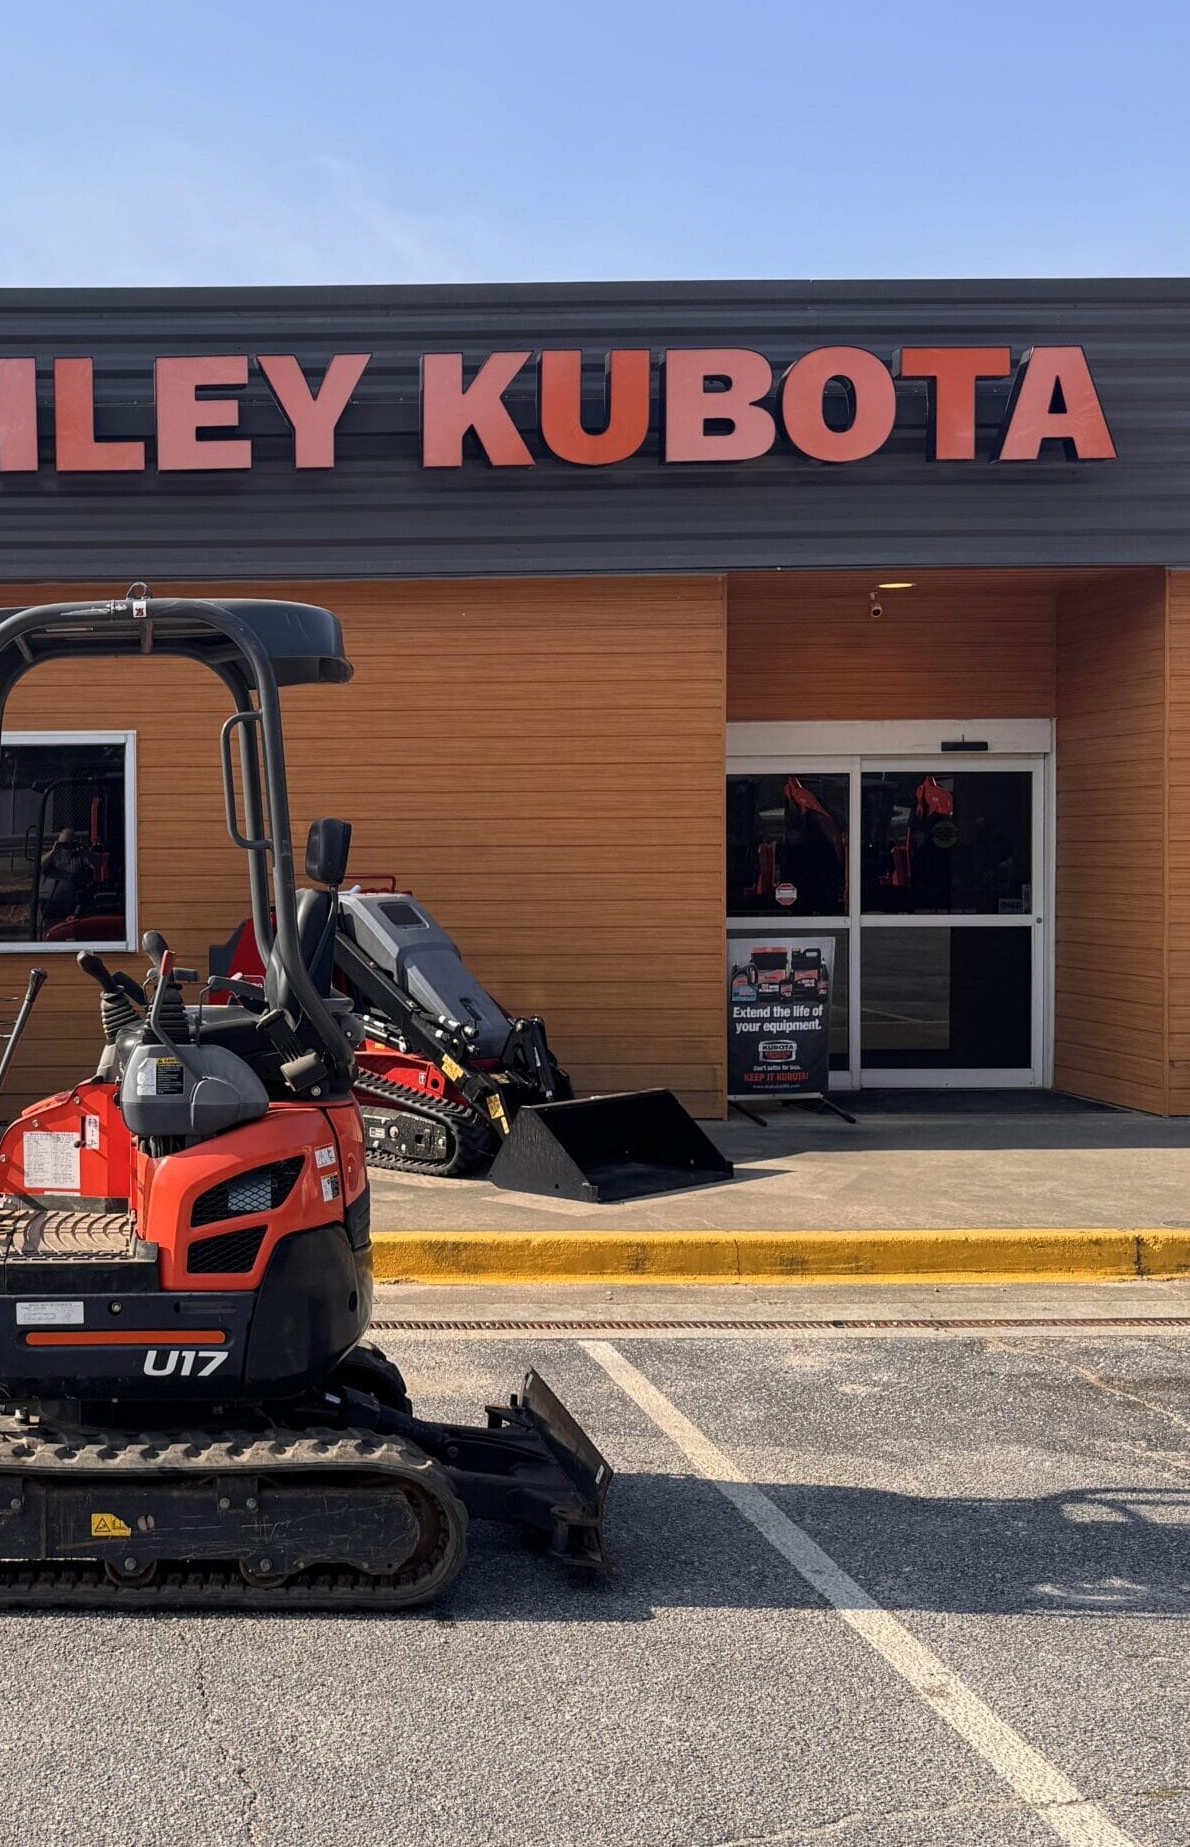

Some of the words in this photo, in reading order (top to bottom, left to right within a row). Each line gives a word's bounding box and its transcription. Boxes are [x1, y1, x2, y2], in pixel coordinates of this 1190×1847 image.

[420, 345, 1117, 468] KUBOTA
[733, 1007, 770, 1018] Extend
[773, 1006, 790, 1017] the
[793, 1005, 810, 1016] life
[812, 1004, 823, 1016] of
[736, 1022, 761, 1034] your
[763, 1019, 822, 1034] equipment.
[745, 1073, 765, 1082] KEEP
[143, 1350, 229, 1377] U17
